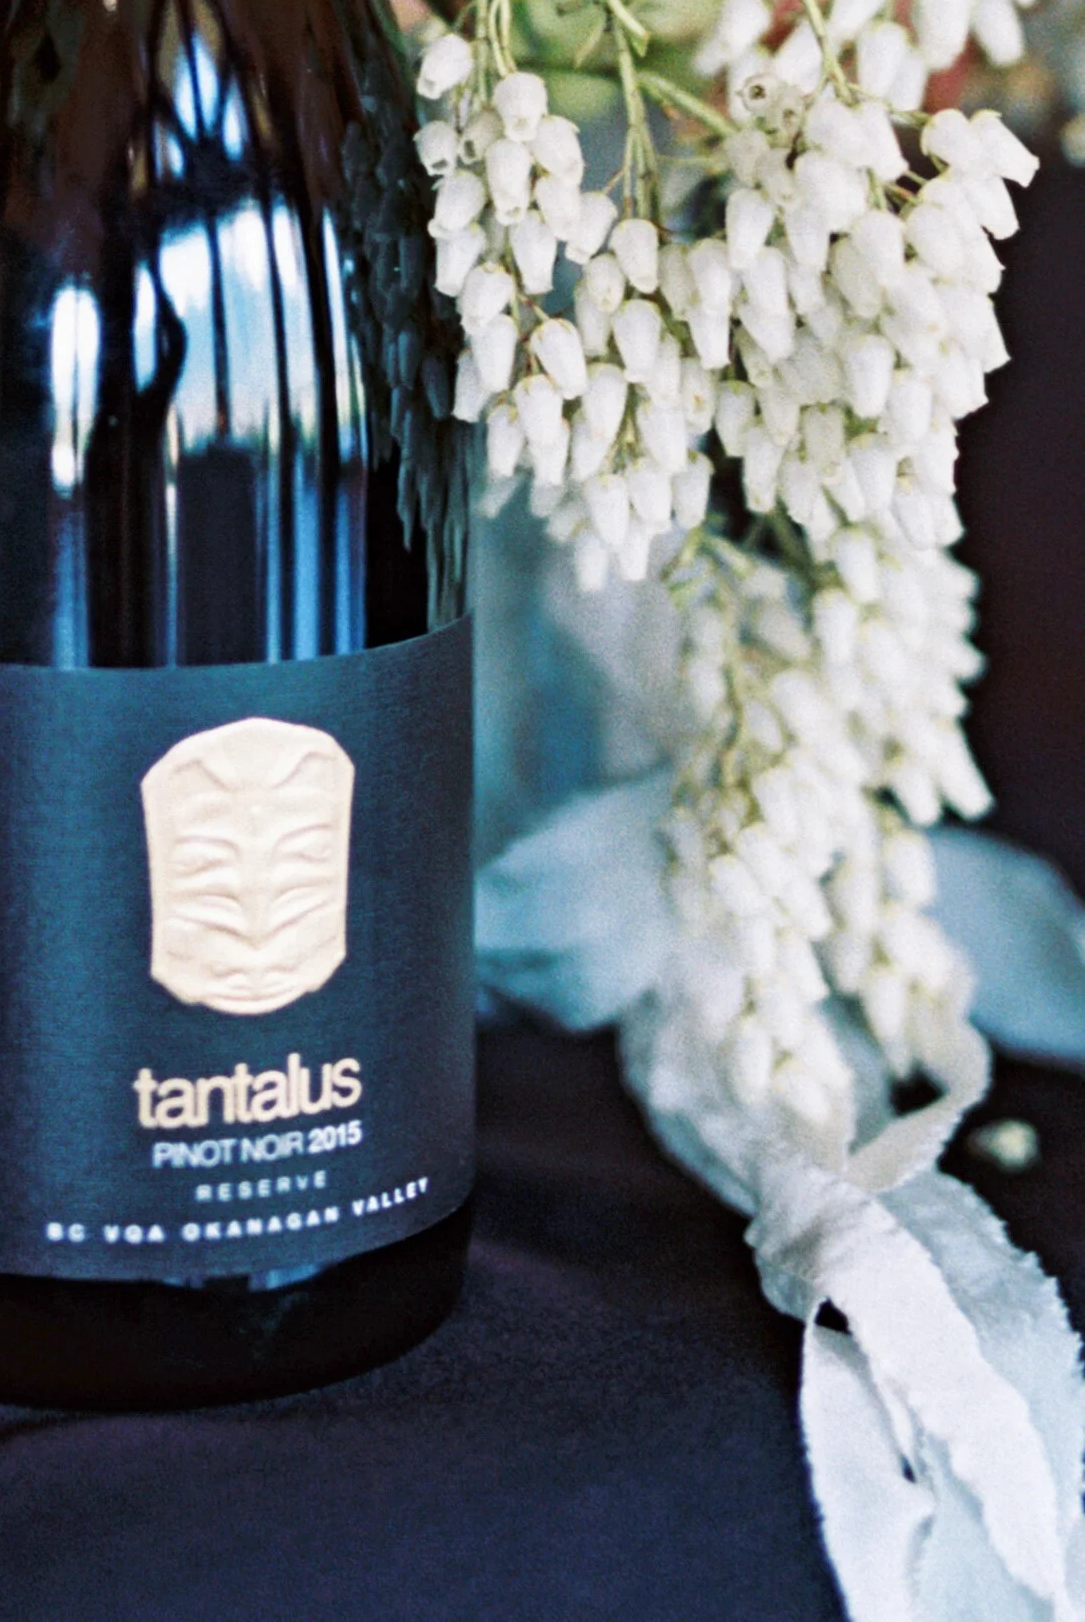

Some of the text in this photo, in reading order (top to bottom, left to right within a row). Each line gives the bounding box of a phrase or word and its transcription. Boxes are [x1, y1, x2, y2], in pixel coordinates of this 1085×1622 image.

[133, 1052, 362, 1128] tantalus
[152, 1120, 363, 1168] PINOT NOIR 2015
[46, 1222, 87, 1242] BC
[181, 1207, 341, 1240] OKANAGAN
[352, 1177, 430, 1217] VALLEY
[195, 1170, 328, 1202] RESERVE
